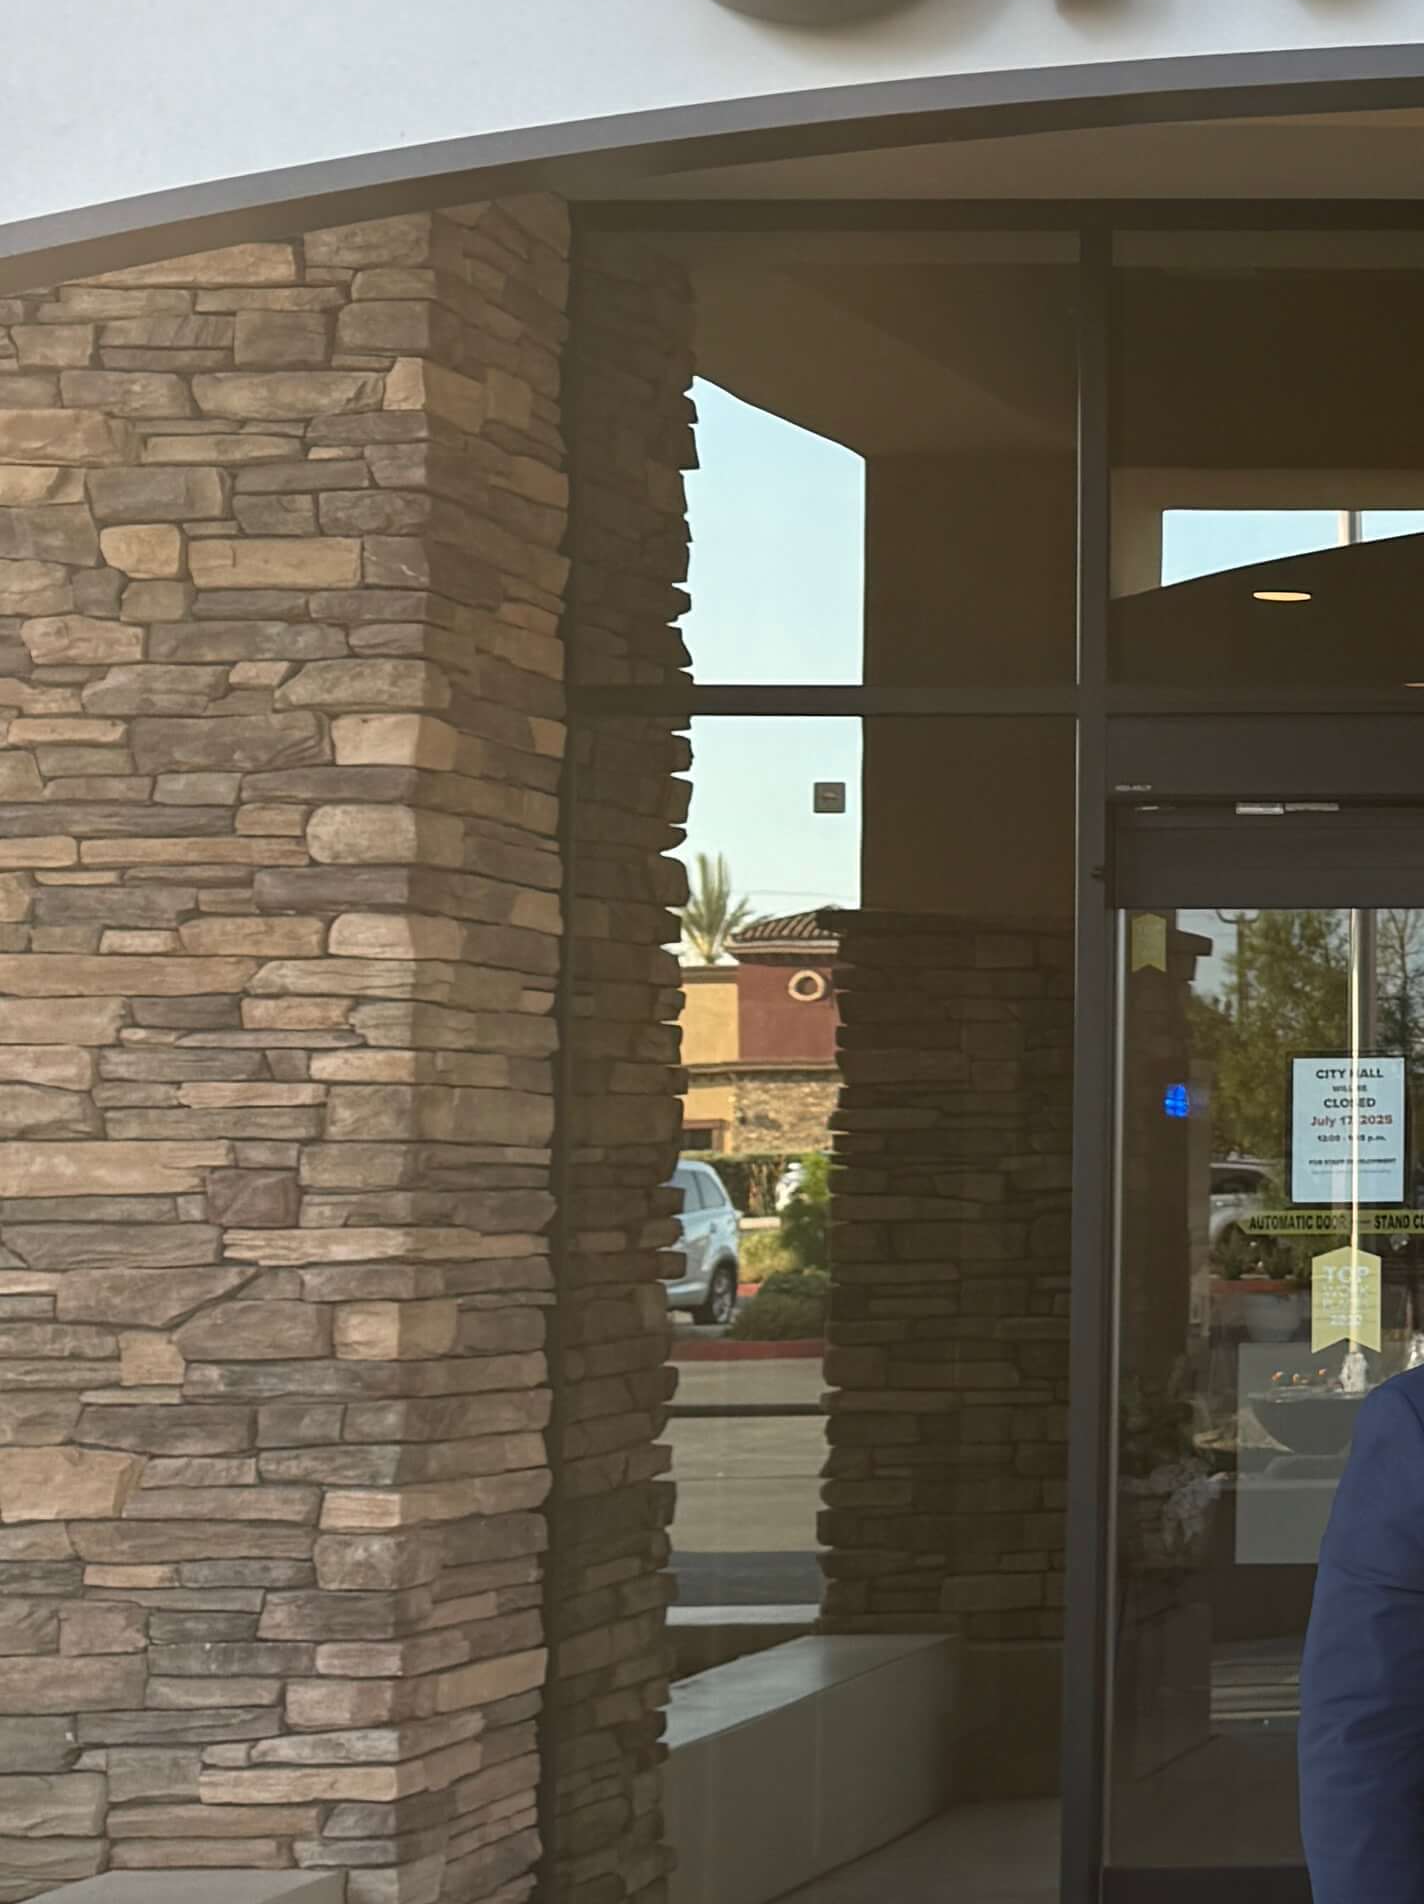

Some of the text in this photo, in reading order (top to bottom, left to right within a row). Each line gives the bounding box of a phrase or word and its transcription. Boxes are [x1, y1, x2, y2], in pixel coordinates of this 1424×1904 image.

[1315, 1068, 1346, 1079] CITY
[1323, 1097, 1376, 1109] CLOED
[1311, 1115, 1336, 1128] July
[1249, 1214, 1313, 1231] AUTOMATIC
[1373, 1213, 1410, 1229] STAND
